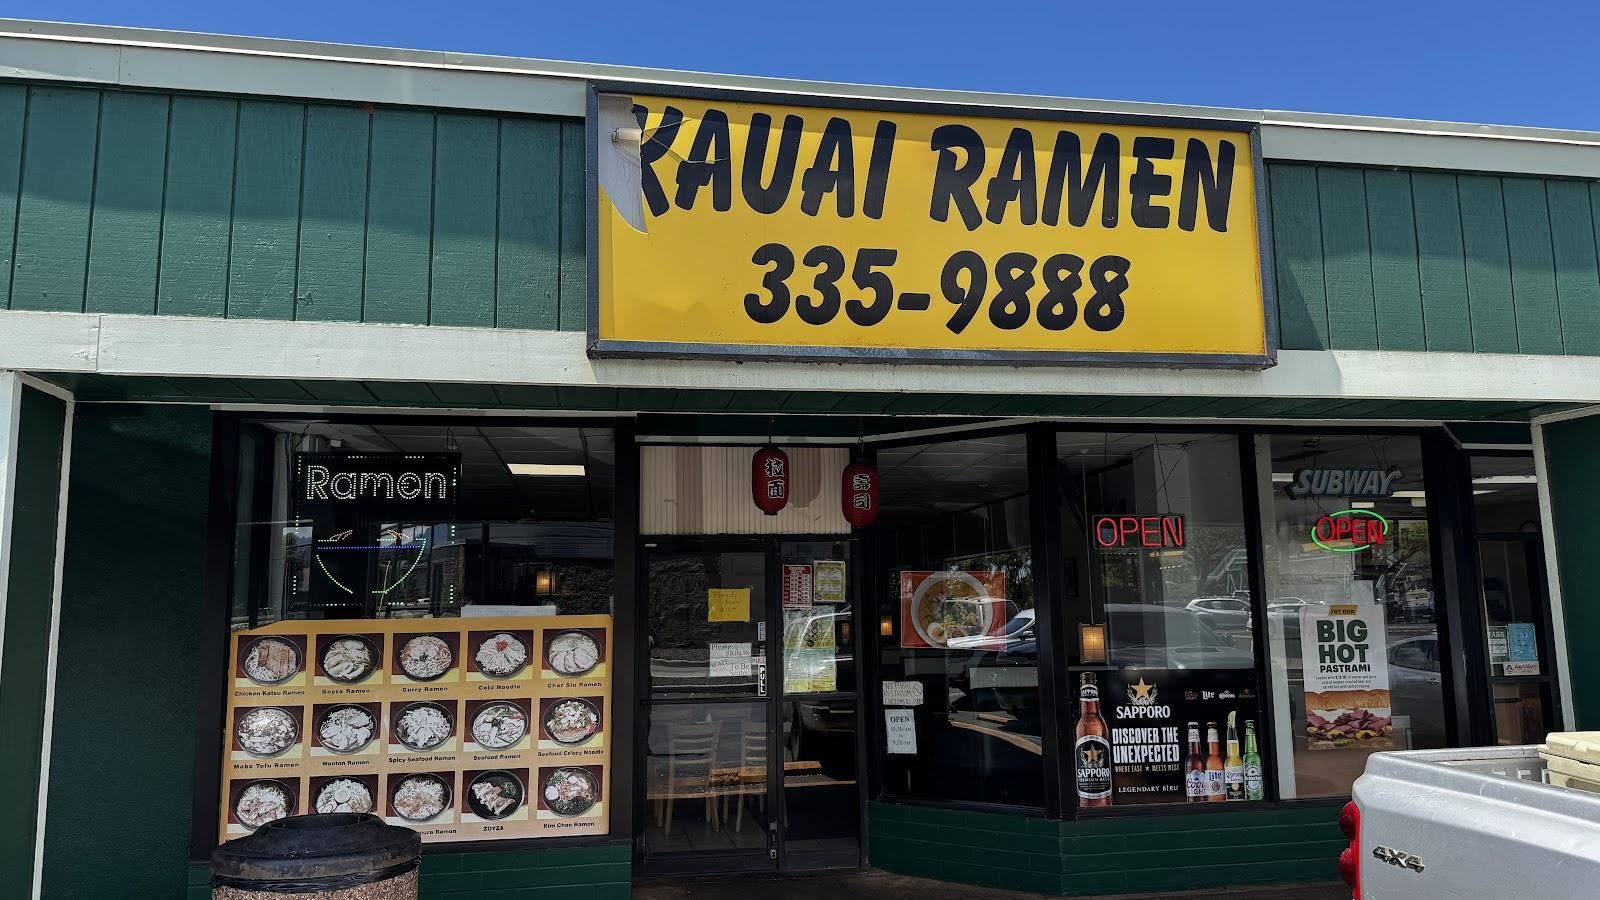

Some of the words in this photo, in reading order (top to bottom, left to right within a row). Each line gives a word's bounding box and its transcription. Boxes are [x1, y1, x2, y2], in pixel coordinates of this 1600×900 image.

[631, 103, 897, 220] KAUAI
[929, 123, 1236, 233] RAMEN
[743, 242, 1131, 334] 335-9888
[306, 464, 447, 500] Ramen
[1288, 465, 1403, 499] SUBWAY
[1096, 515, 1184, 547] OPEN
[1315, 515, 1384, 545] OPEN
[1316, 619, 1368, 643] BIG
[1318, 643, 1369, 664] HOT
[1320, 664, 1371, 673] PASTRAMI
[1116, 705, 1171, 720] SAPPORO
[1112, 727, 1160, 745] DISCOVER
[1161, 726, 1179, 743] THE
[1113, 744, 1180, 764] UNEXPECTED
[1077, 767, 1110, 779] SAPPORO
[1114, 765, 1131, 773] WHERE
[1131, 764, 1143, 772] EAST
[1151, 764, 1167, 772] MEETS
[1167, 763, 1180, 771] WEST
[1208, 771, 1222, 781] Lite
[1118, 785, 1160, 793] LEGENDARY
